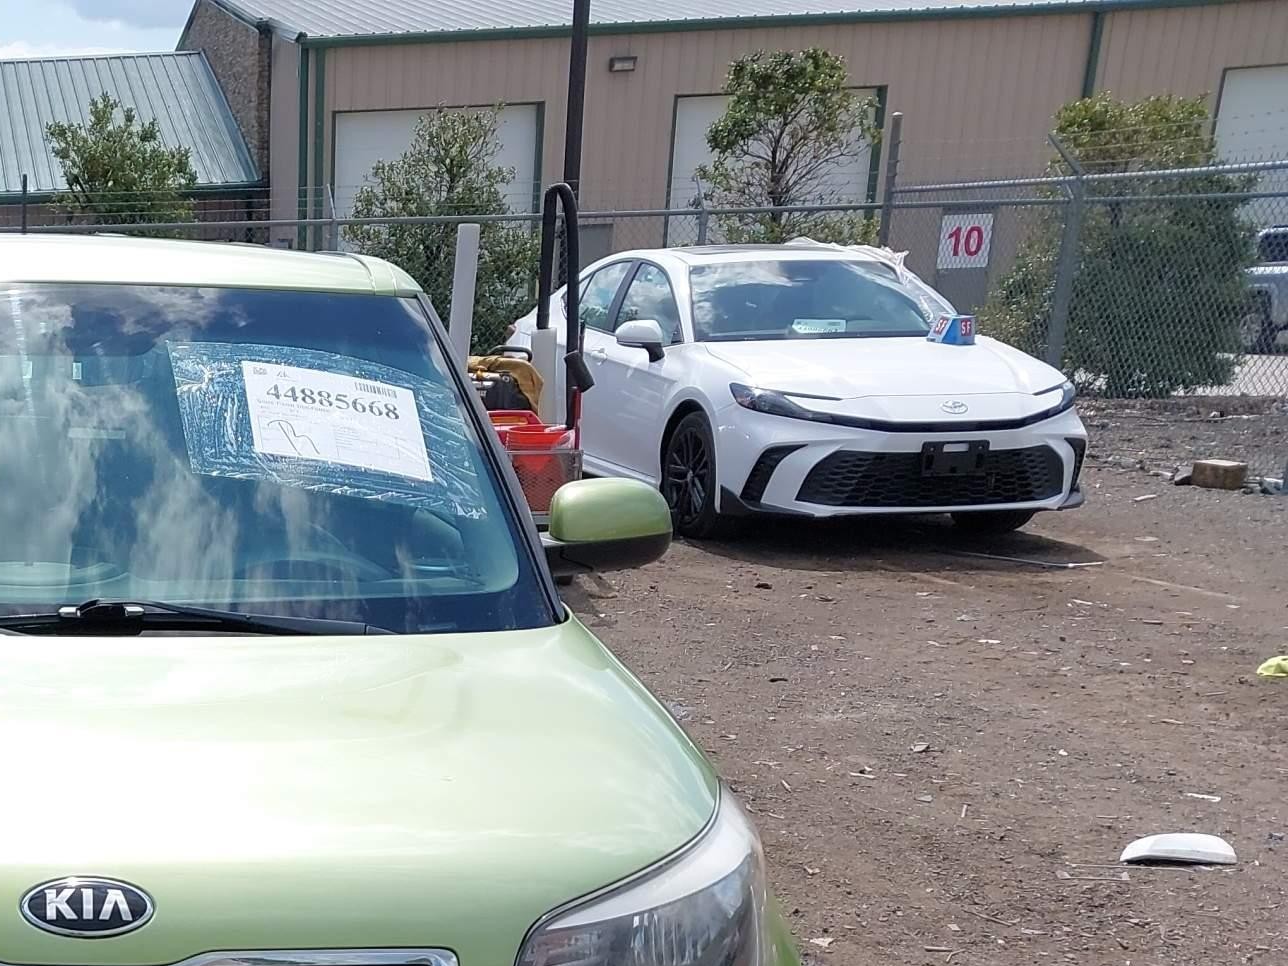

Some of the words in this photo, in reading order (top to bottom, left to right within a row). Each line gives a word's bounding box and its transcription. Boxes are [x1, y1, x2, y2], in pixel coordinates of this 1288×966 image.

[948, 226, 984, 256] 10
[266, 383, 400, 421] 44885668
[44, 888, 133, 921] KIA
